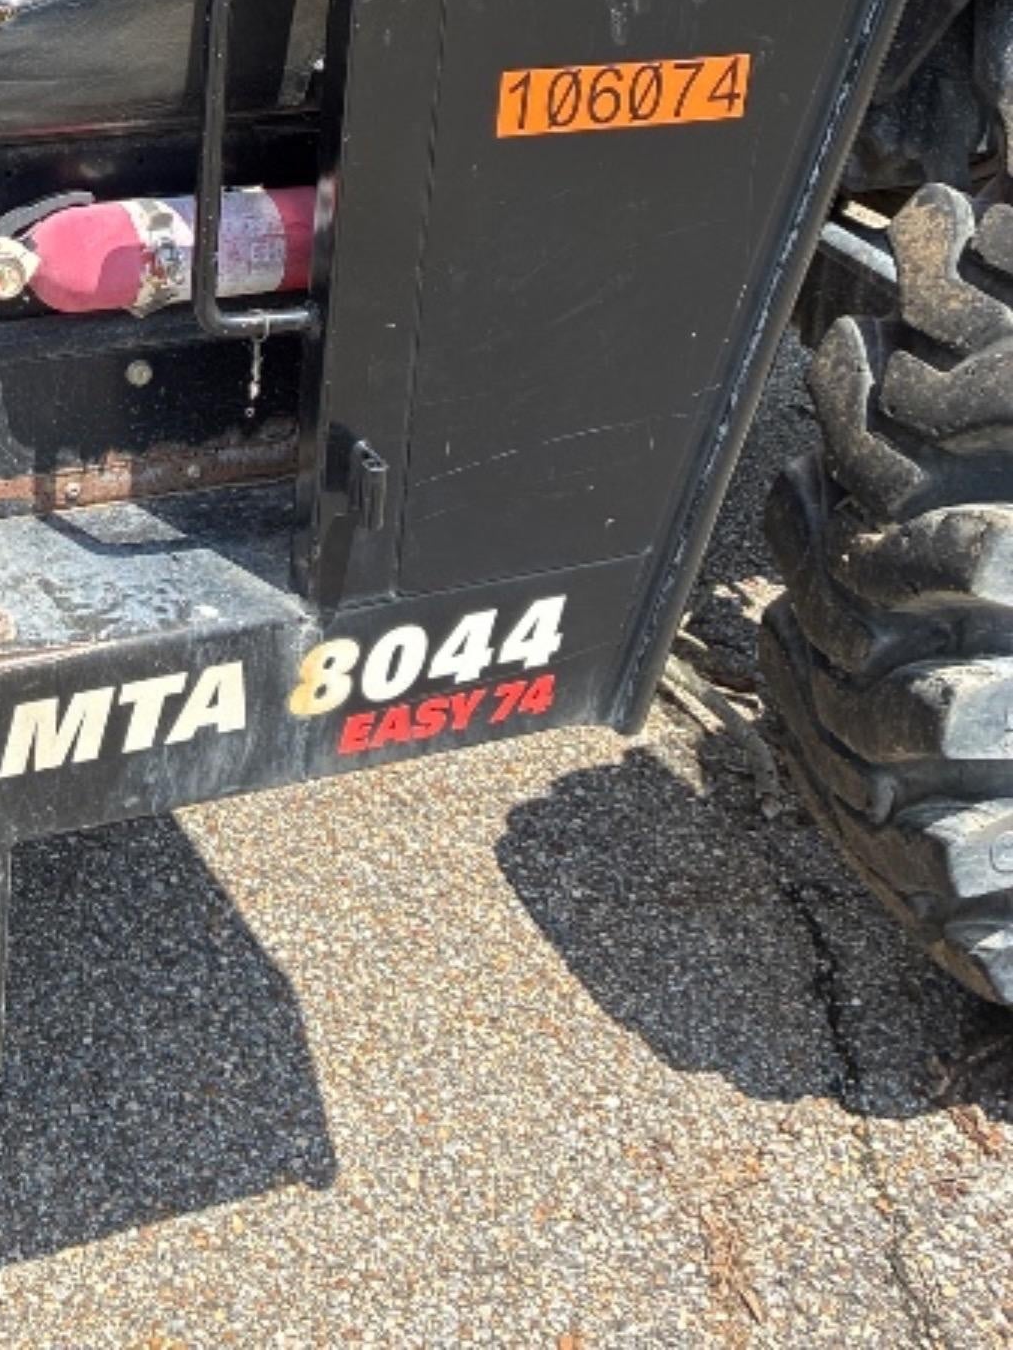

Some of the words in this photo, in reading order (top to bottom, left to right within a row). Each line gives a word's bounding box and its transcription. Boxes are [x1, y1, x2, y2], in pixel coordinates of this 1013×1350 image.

[508, 57, 742, 130] 106074
[288, 593, 568, 720] 8044
[337, 688, 487, 756] EASY
[490, 673, 556, 725] 74
